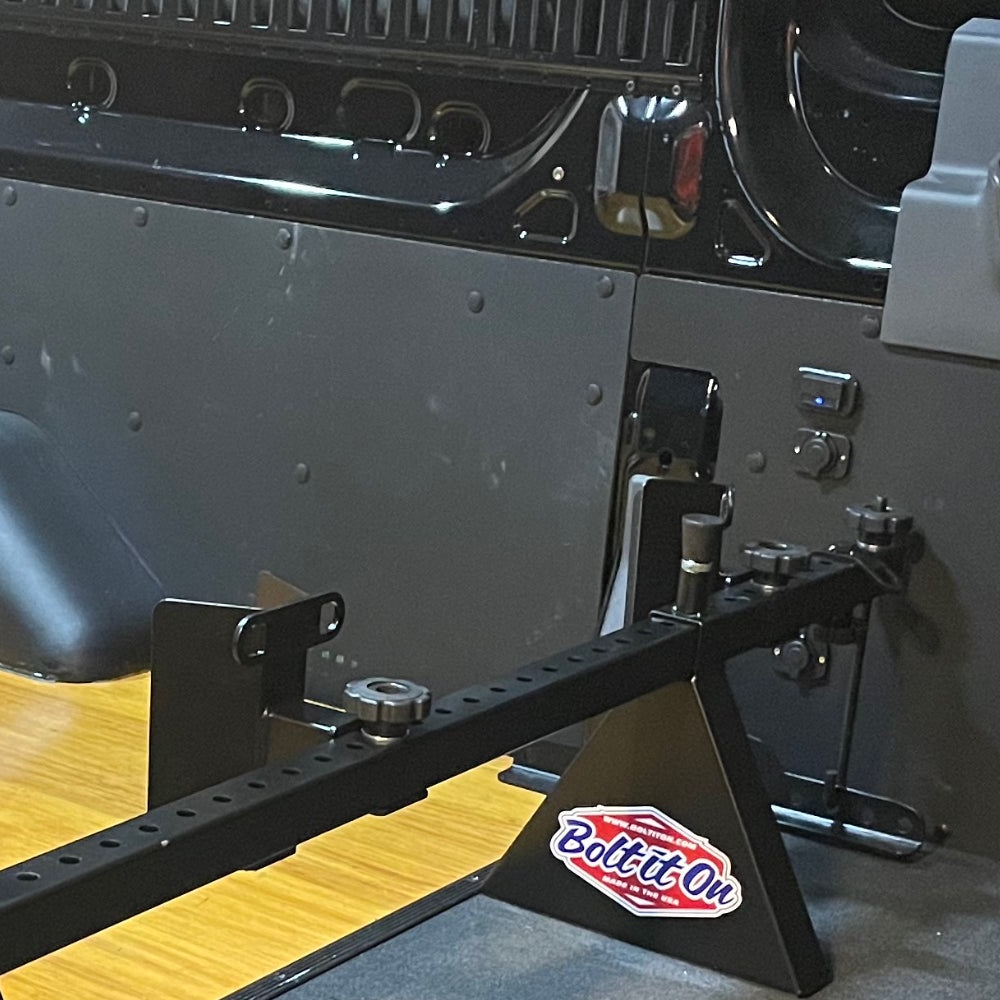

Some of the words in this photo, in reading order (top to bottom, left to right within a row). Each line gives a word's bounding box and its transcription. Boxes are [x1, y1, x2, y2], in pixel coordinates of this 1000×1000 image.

[602, 815, 698, 851] WWW.BOLTITON.COM
[557, 819, 645, 873] Bolt
[640, 849, 685, 886] it
[683, 863, 735, 905] On
[601, 875, 628, 889] MADE
[642, 888, 659, 900] THE
[661, 894, 680, 906] USA
